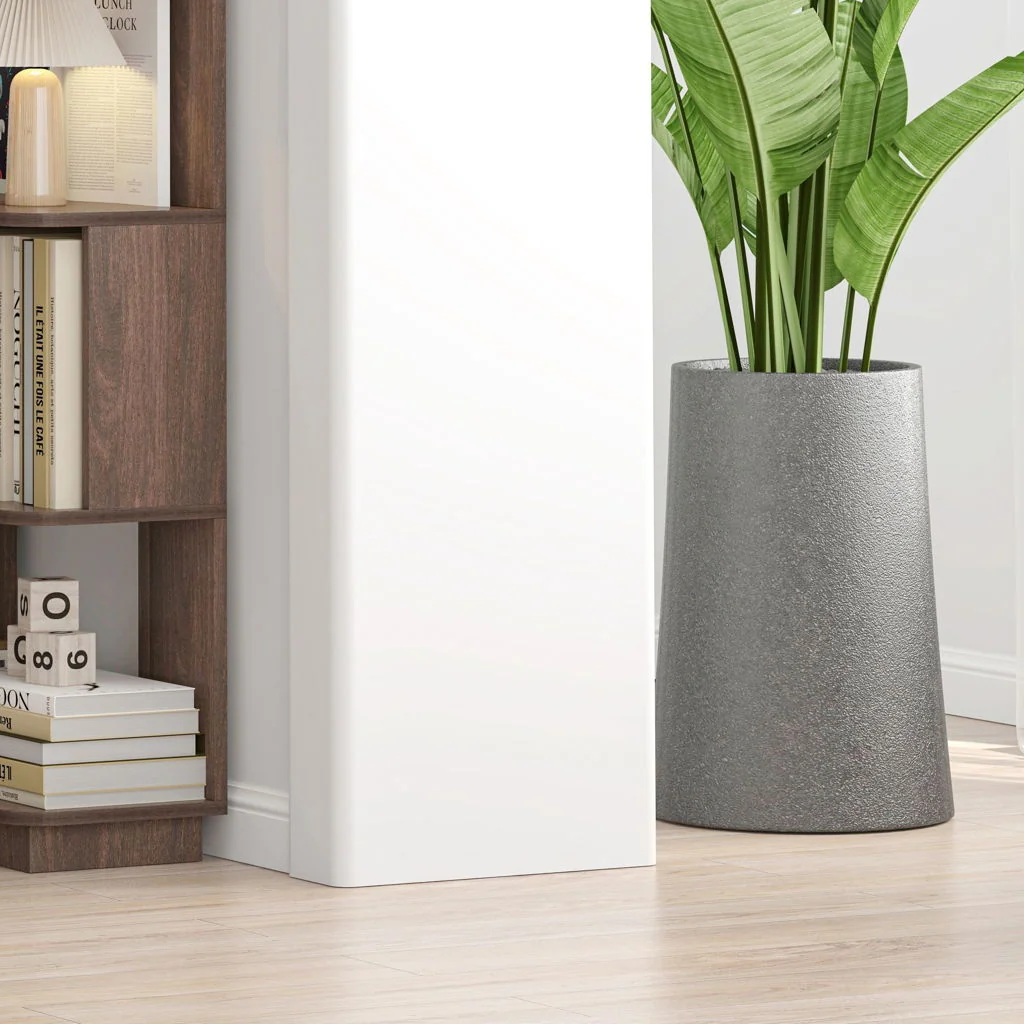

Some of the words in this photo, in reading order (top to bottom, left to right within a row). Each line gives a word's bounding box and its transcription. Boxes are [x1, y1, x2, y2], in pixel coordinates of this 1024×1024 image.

[35, 305, 44, 316] IL
[35, 319, 45, 352] ÉTAIT
[35, 354, 44, 378] UNE
[35, 381, 44, 407] FOIS
[35, 410, 44, 423] LE
[35, 426, 45, 456] CAFÉ
